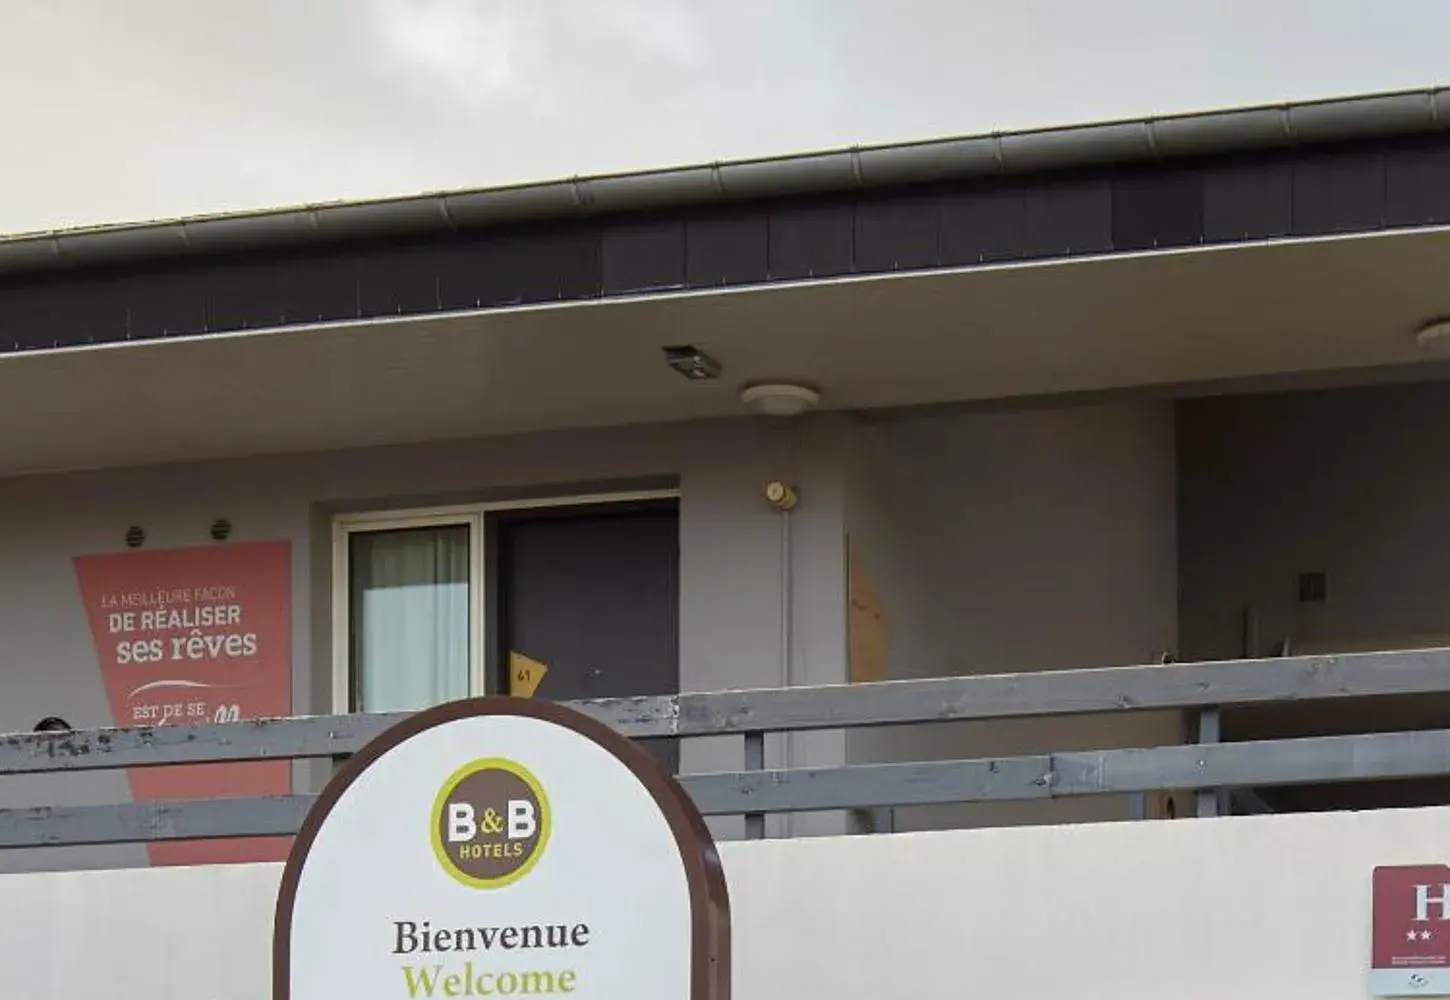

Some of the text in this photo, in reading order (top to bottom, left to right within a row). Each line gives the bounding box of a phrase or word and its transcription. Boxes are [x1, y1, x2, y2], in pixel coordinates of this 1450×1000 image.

[109, 604, 241, 633] DE RÉALISER
[116, 628, 257, 664] ses rêves
[133, 705, 159, 720] EST
[163, 703, 184, 718] DE
[187, 702, 206, 717] SE
[446, 798, 538, 843] B&B
[458, 842, 523, 860] HOTELS
[392, 917, 591, 955] Bienvenue
[401, 960, 577, 1000] Welcome
